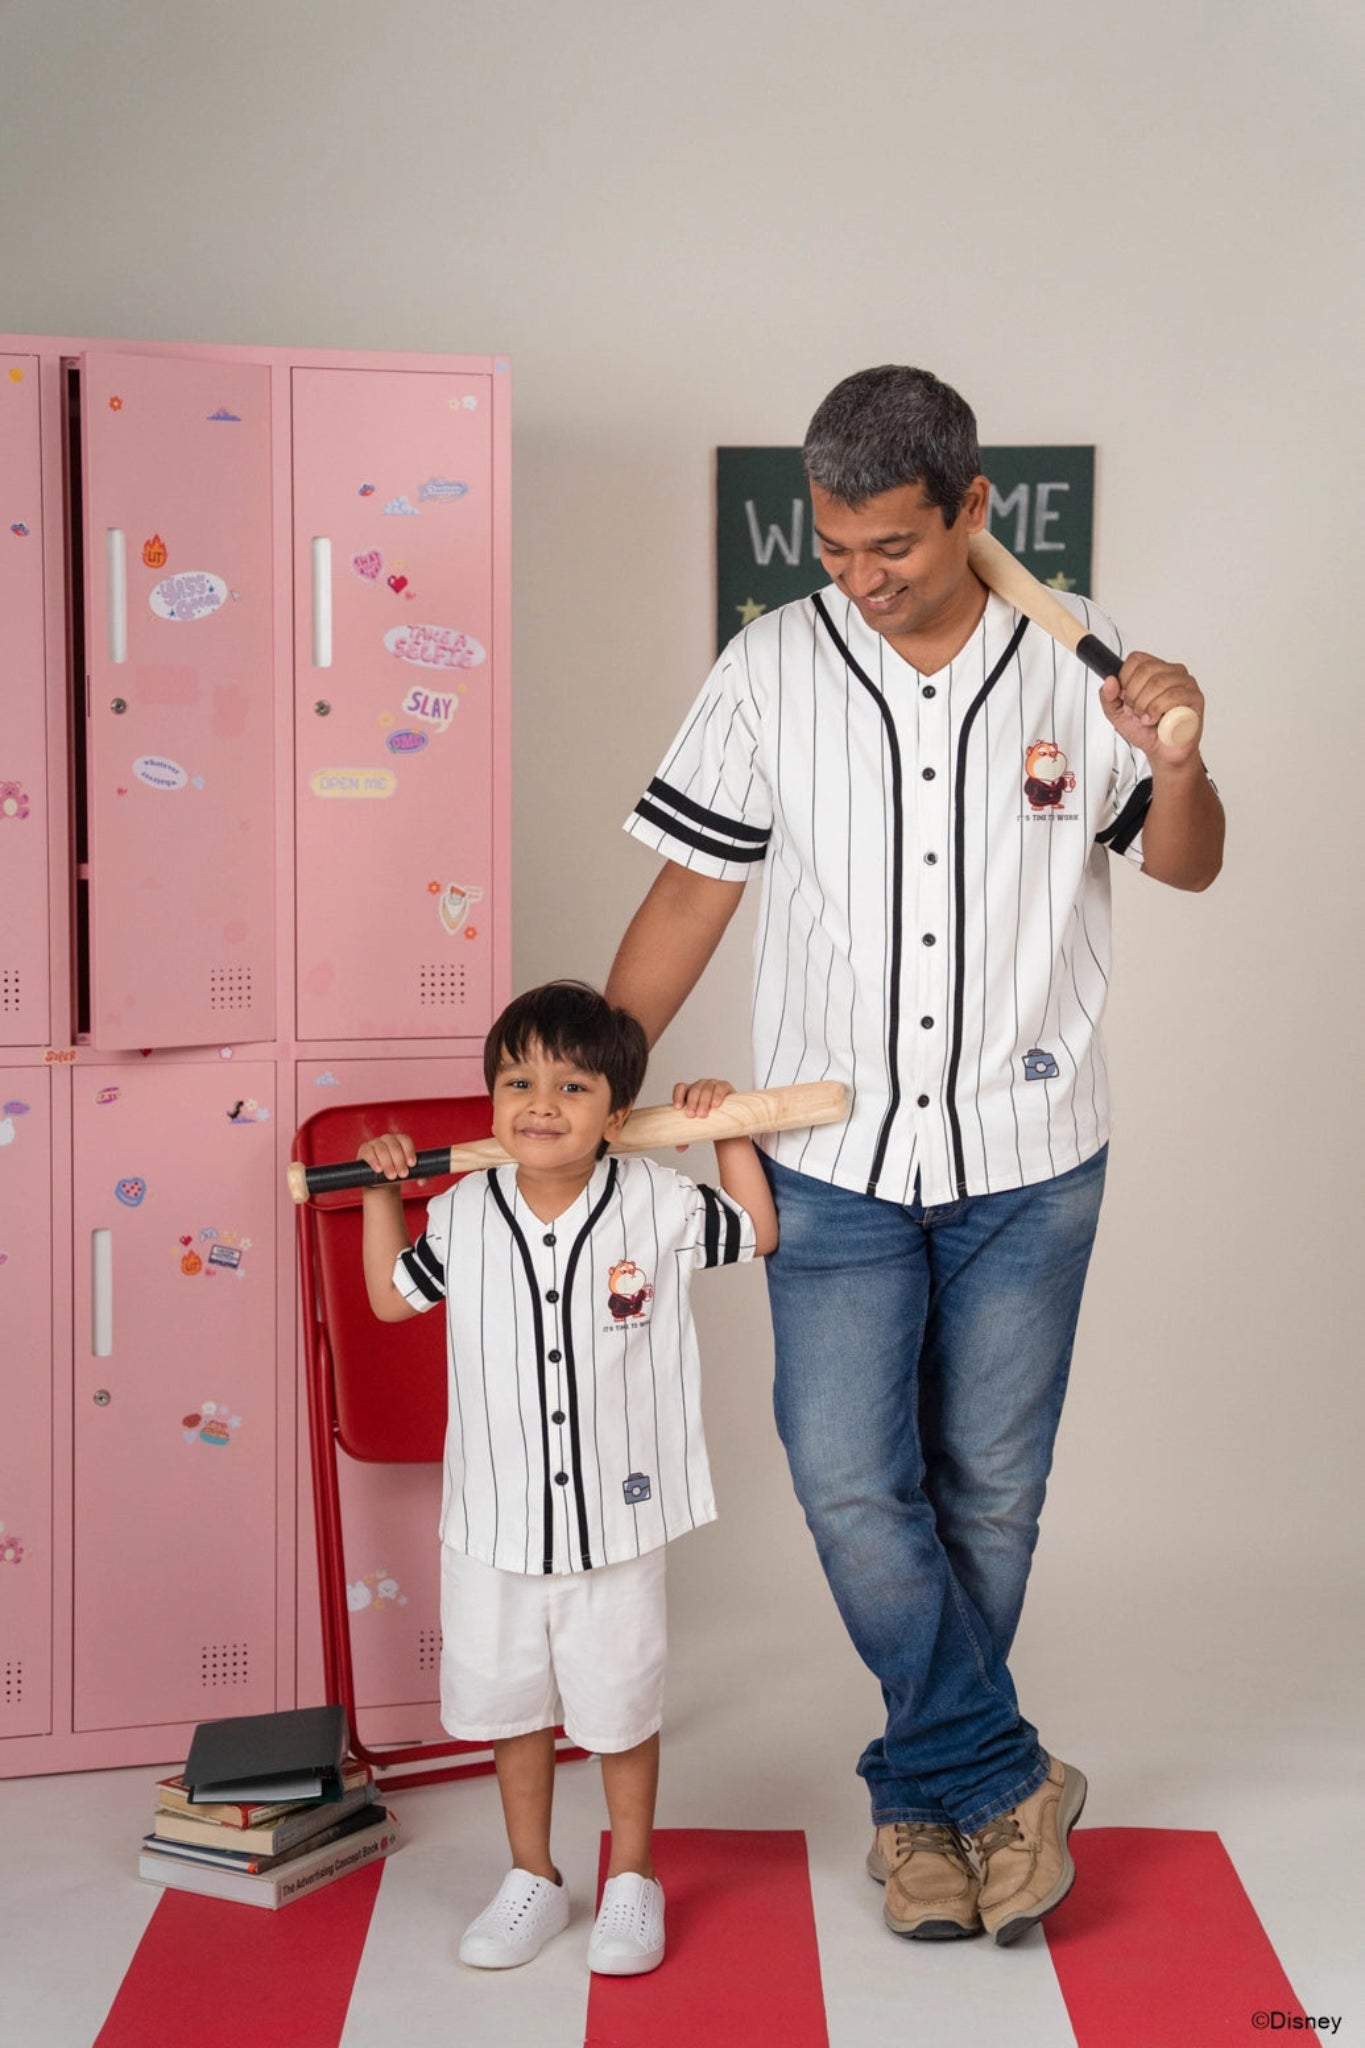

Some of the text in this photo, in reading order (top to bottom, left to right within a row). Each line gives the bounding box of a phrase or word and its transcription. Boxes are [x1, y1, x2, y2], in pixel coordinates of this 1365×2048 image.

[407, 624, 467, 648] TAKE A
[393, 639, 475, 669] SELFIE
[407, 691, 452, 720] SLAY
[319, 776, 388, 791] OPEN ME
[282, 1841, 380, 1896] The Advertising Concept Book
